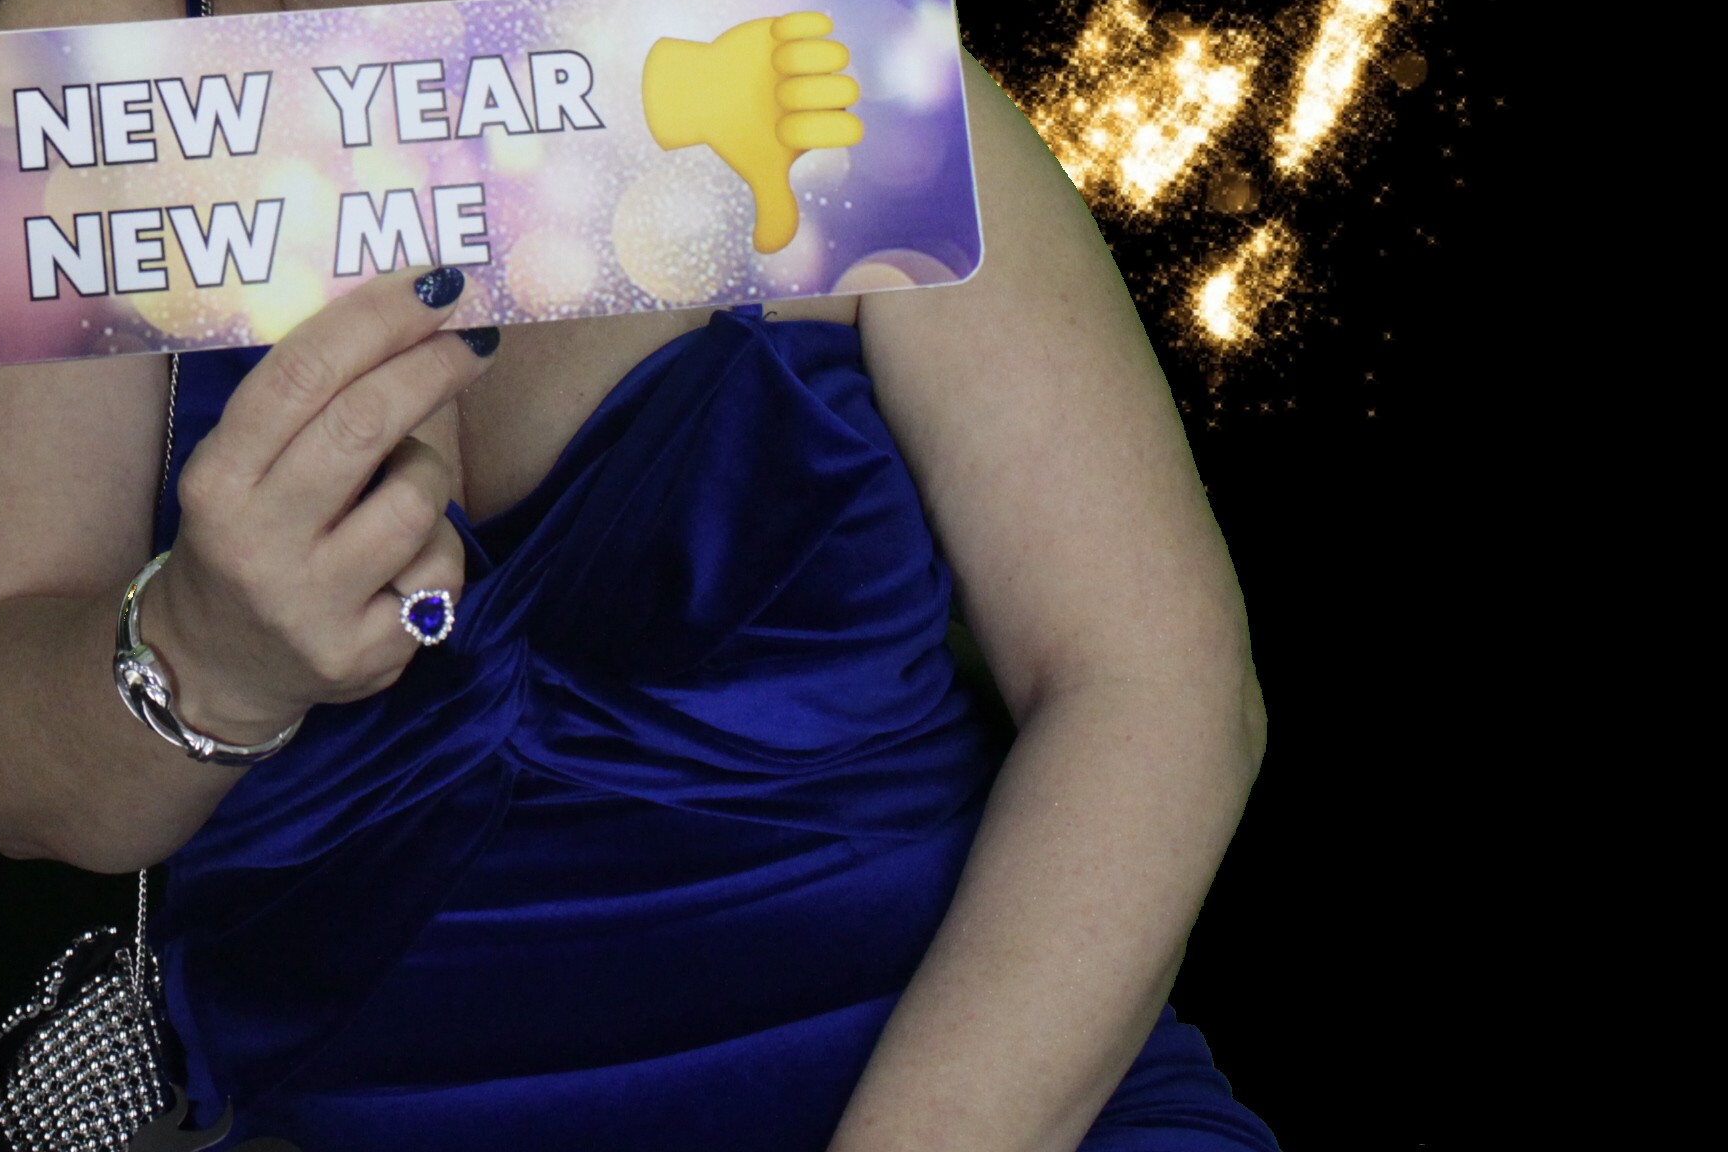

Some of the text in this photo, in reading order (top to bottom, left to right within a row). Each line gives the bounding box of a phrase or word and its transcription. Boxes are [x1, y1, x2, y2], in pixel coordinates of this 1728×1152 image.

[14, 50, 606, 172] NEW YEAR
[23, 184, 492, 302] NEW ME
